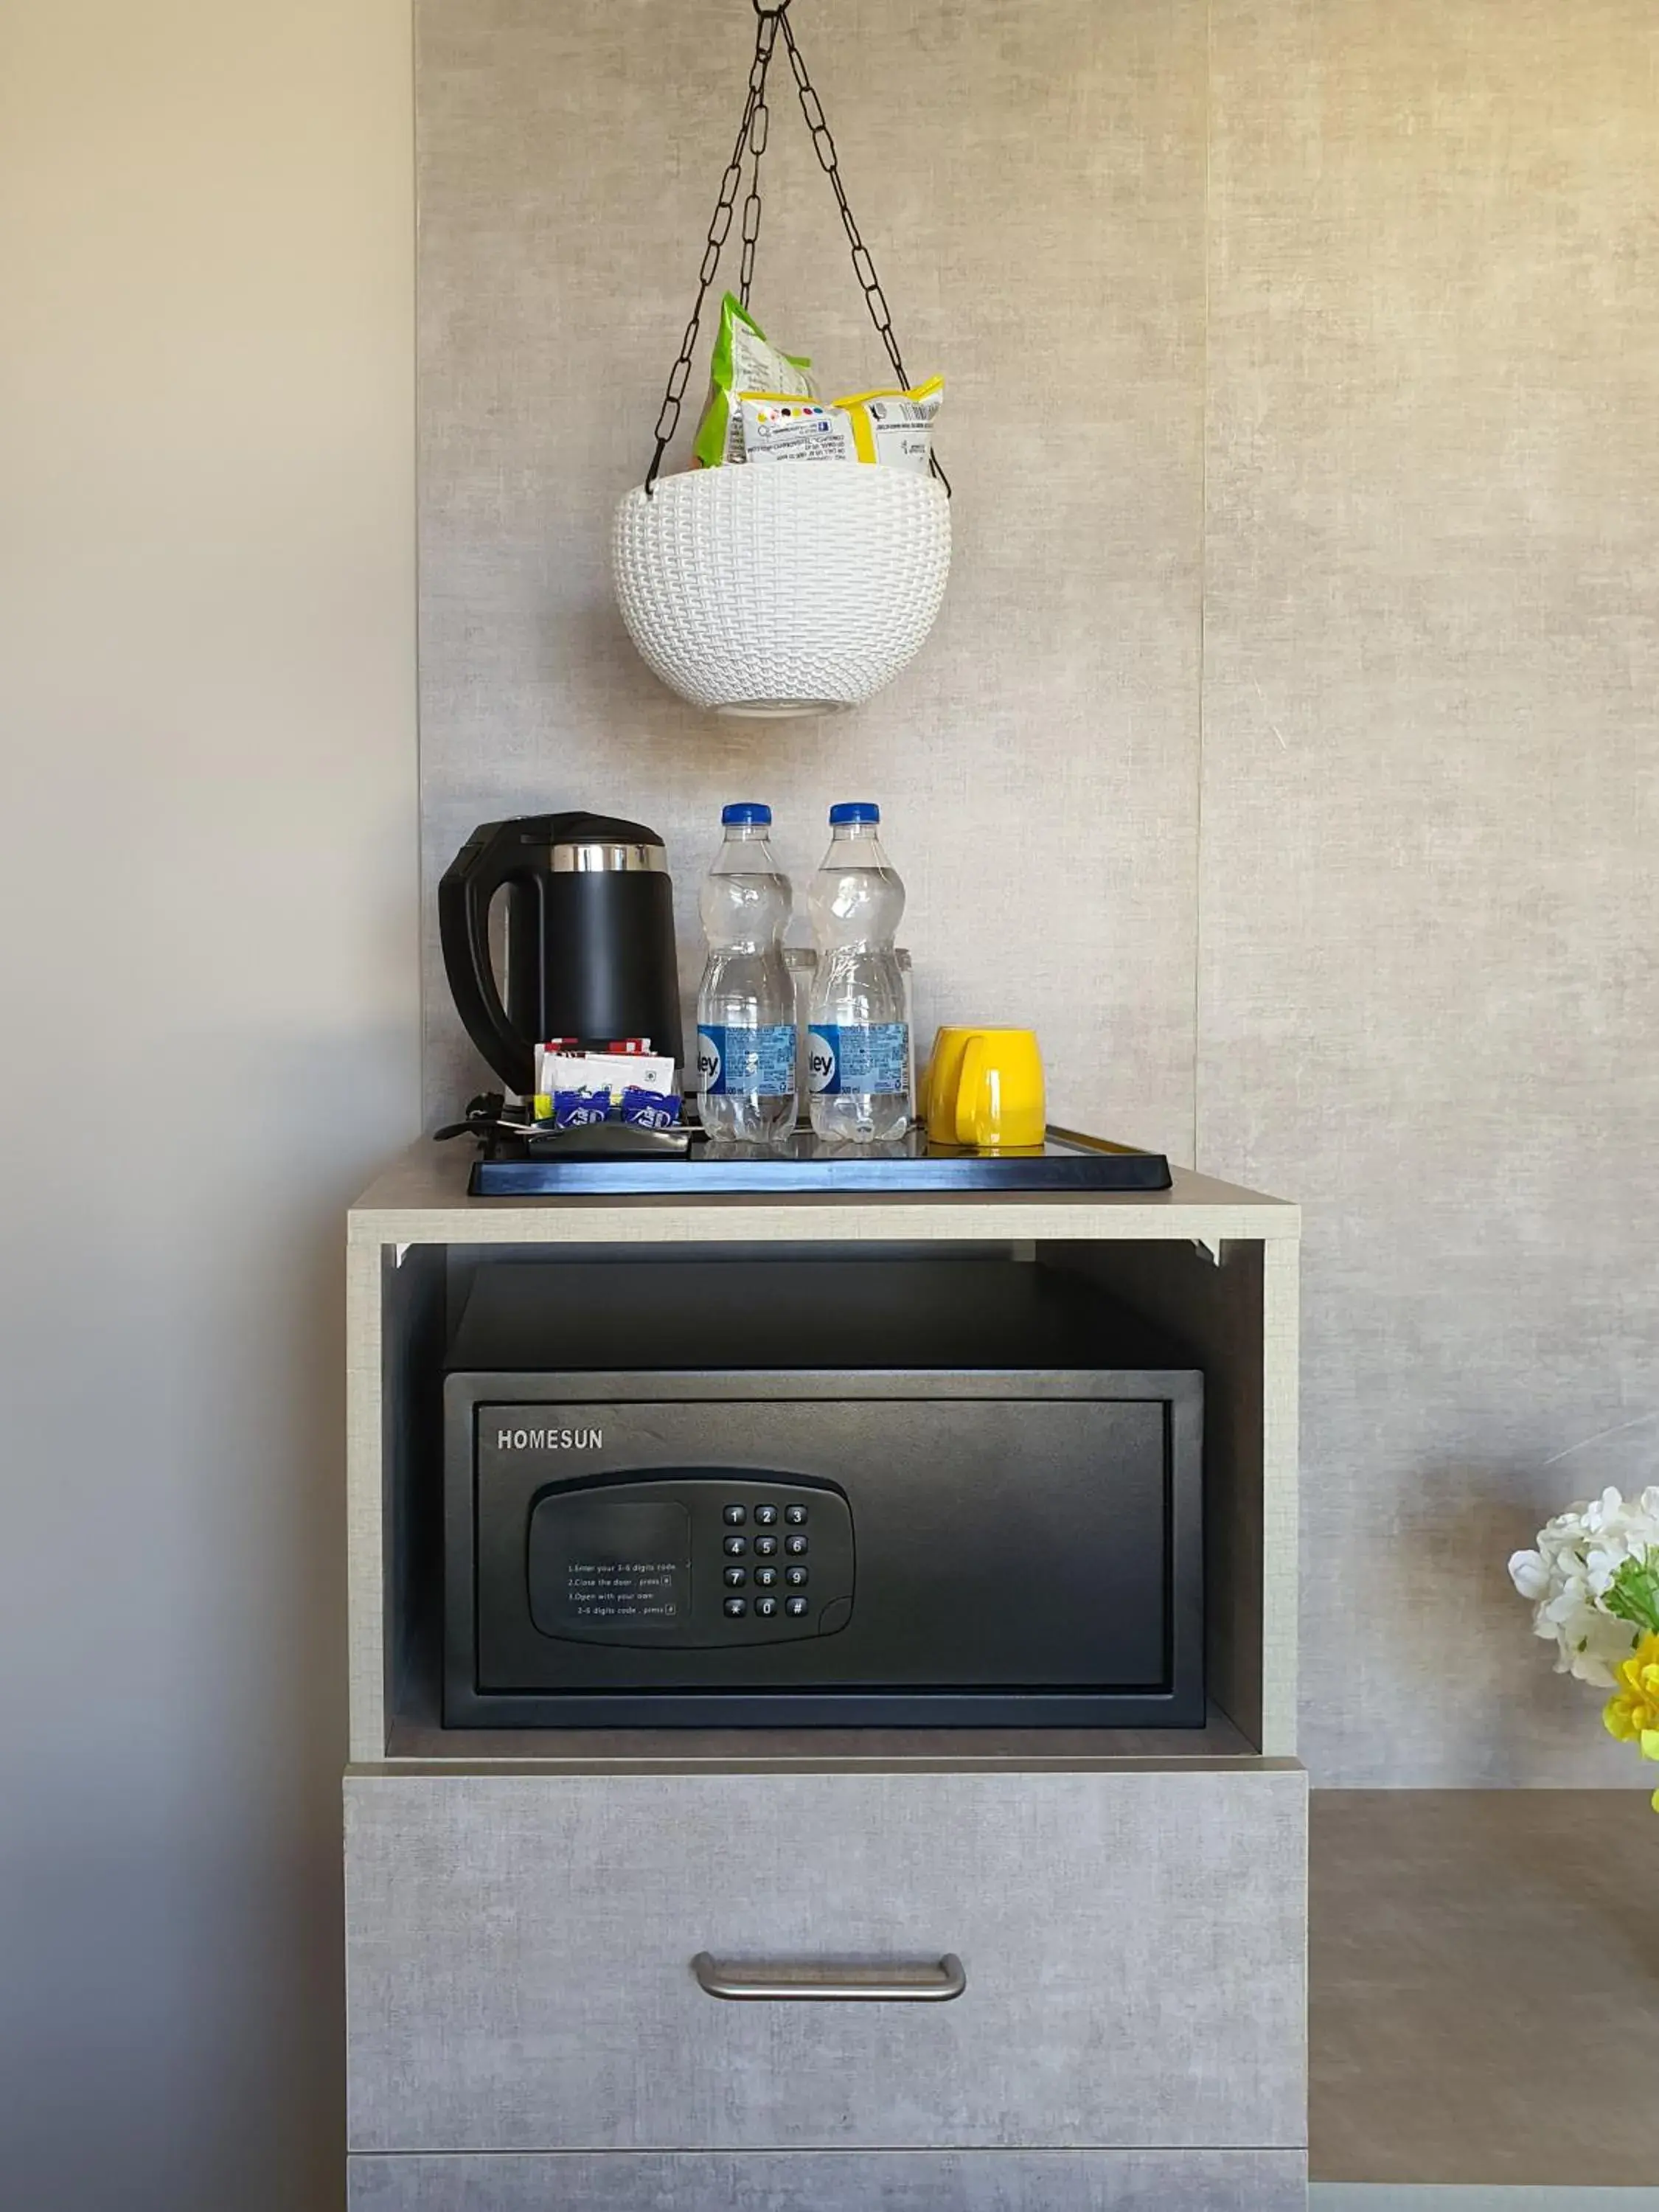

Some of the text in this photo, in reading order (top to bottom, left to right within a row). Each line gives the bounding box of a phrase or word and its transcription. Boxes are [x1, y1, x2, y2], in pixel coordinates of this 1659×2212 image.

[498, 1429, 603, 1449] HOMESUN
[731, 1511, 801, 1523] 1 2 3
[731, 1540, 801, 1554] 4 5 6
[597, 1565, 615, 1574] your
[632, 1563, 654, 1573] digits
[598, 1578, 611, 1586] the
[639, 1578, 659, 1587] press
[731, 1572, 801, 1584] 7 8 9
[598, 1592, 615, 1600] with
[617, 1593, 636, 1602] your
[593, 1607, 615, 1615] digits
[643, 1607, 664, 1615] press
[763, 1603, 771, 1614] 0
